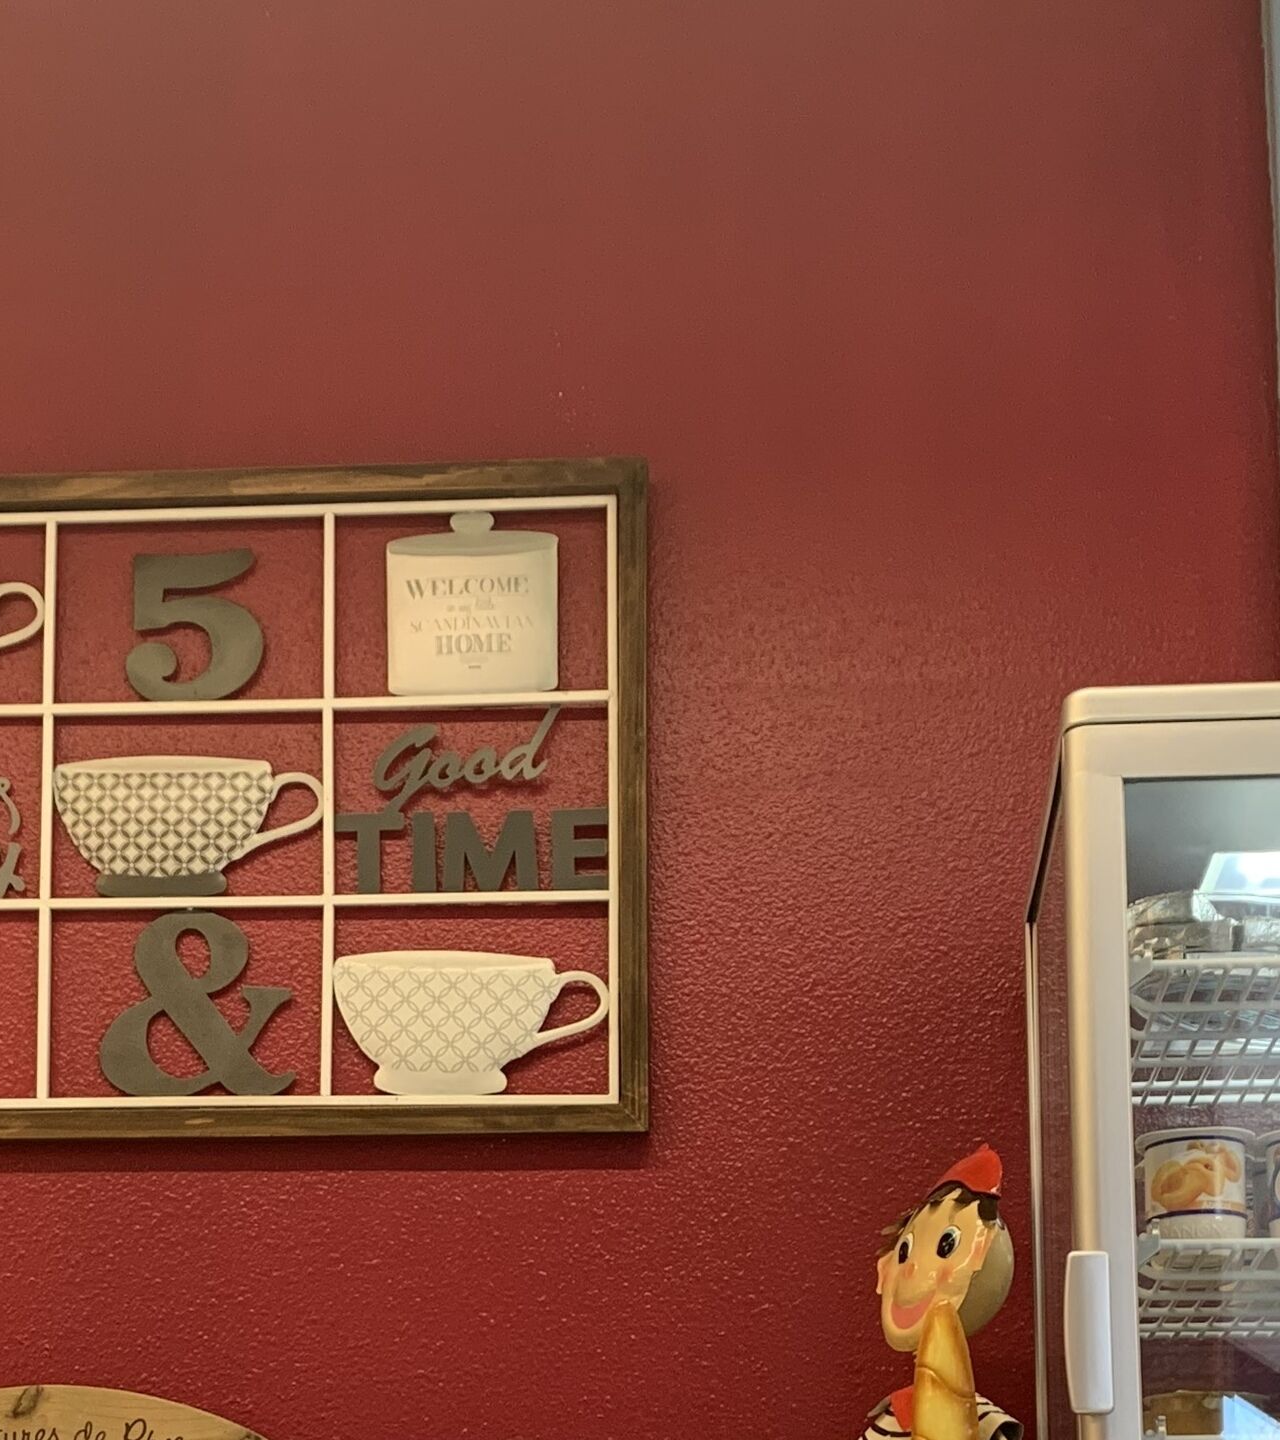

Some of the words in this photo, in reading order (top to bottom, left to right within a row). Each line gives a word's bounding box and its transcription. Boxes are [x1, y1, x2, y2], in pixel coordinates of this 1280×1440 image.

[126, 548, 264, 701] 5
[406, 576, 529, 600] WELCOME
[435, 632, 512, 656] HOME
[373, 704, 561, 818] Good
[334, 808, 609, 894] TIME
[100, 911, 295, 1096] &
